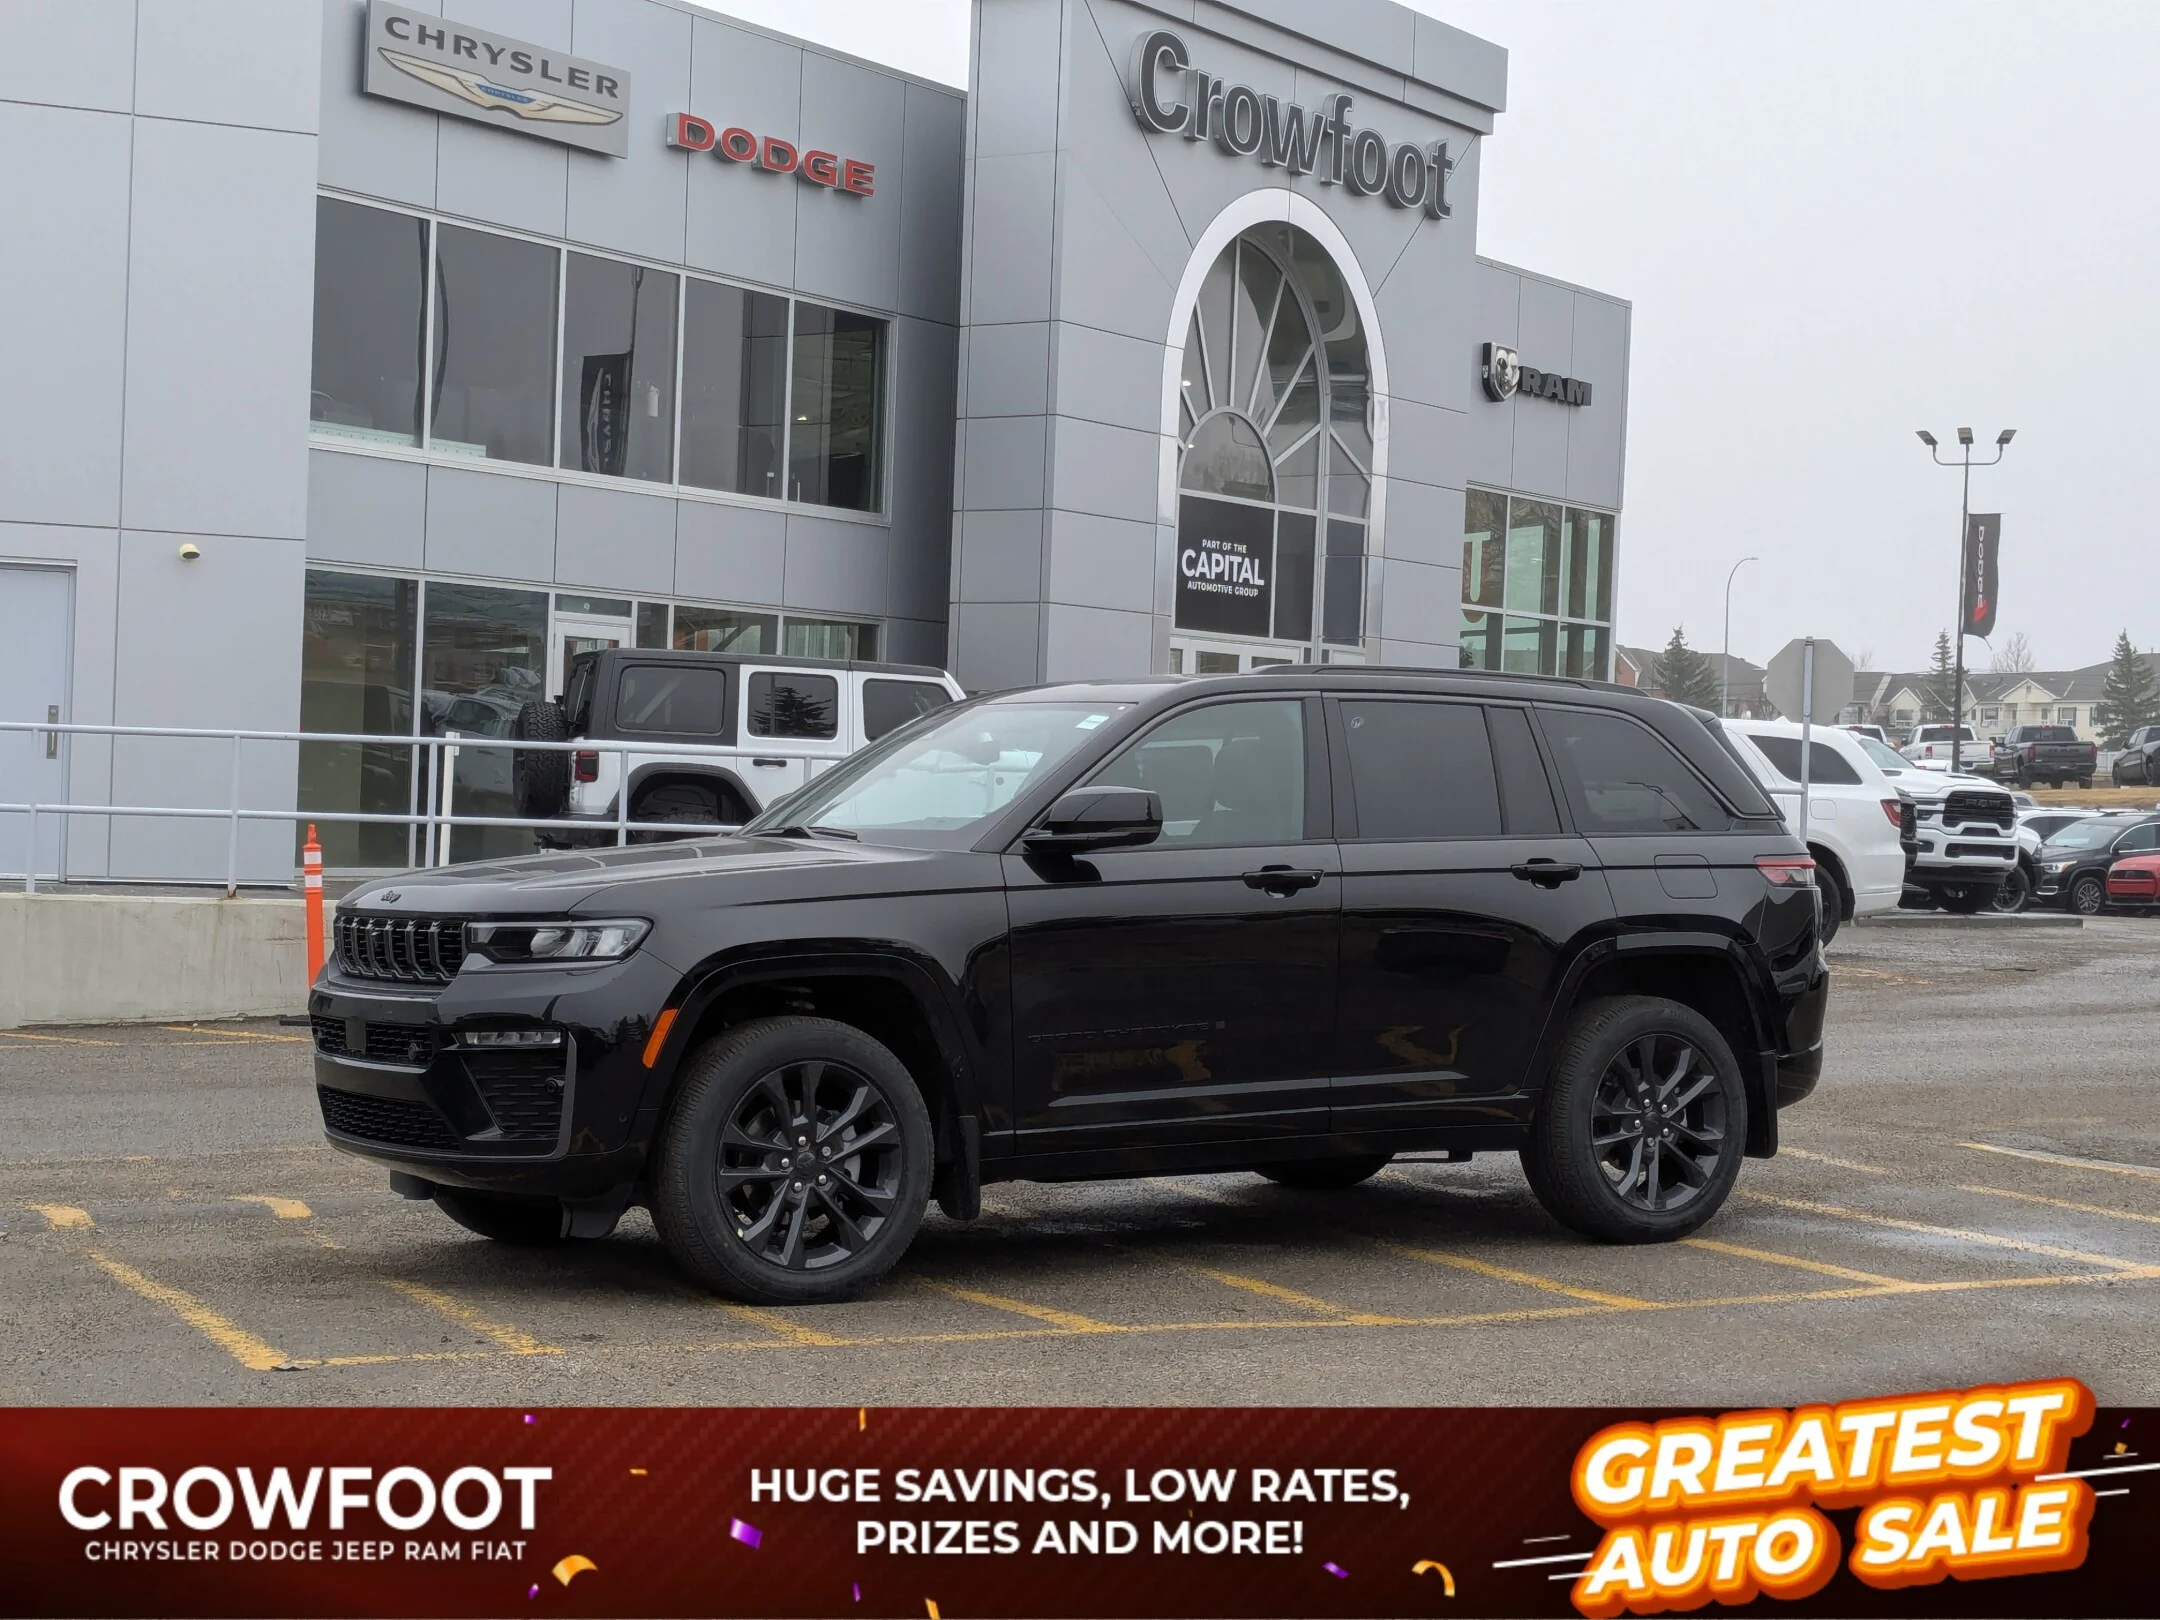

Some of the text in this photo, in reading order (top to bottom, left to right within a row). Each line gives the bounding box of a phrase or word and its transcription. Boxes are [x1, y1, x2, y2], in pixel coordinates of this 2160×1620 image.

[384, 15, 620, 99] CHRYSLER
[1133, 29, 1454, 220] Crowfoot
[674, 112, 876, 197] DODGE
[1519, 365, 1592, 407] RAM
[1181, 548, 1265, 586] CAPITAL
[1202, 539, 1247, 554] PART OF THE
[1187, 580, 1259, 598] AUTOMOTIVE GROUP
